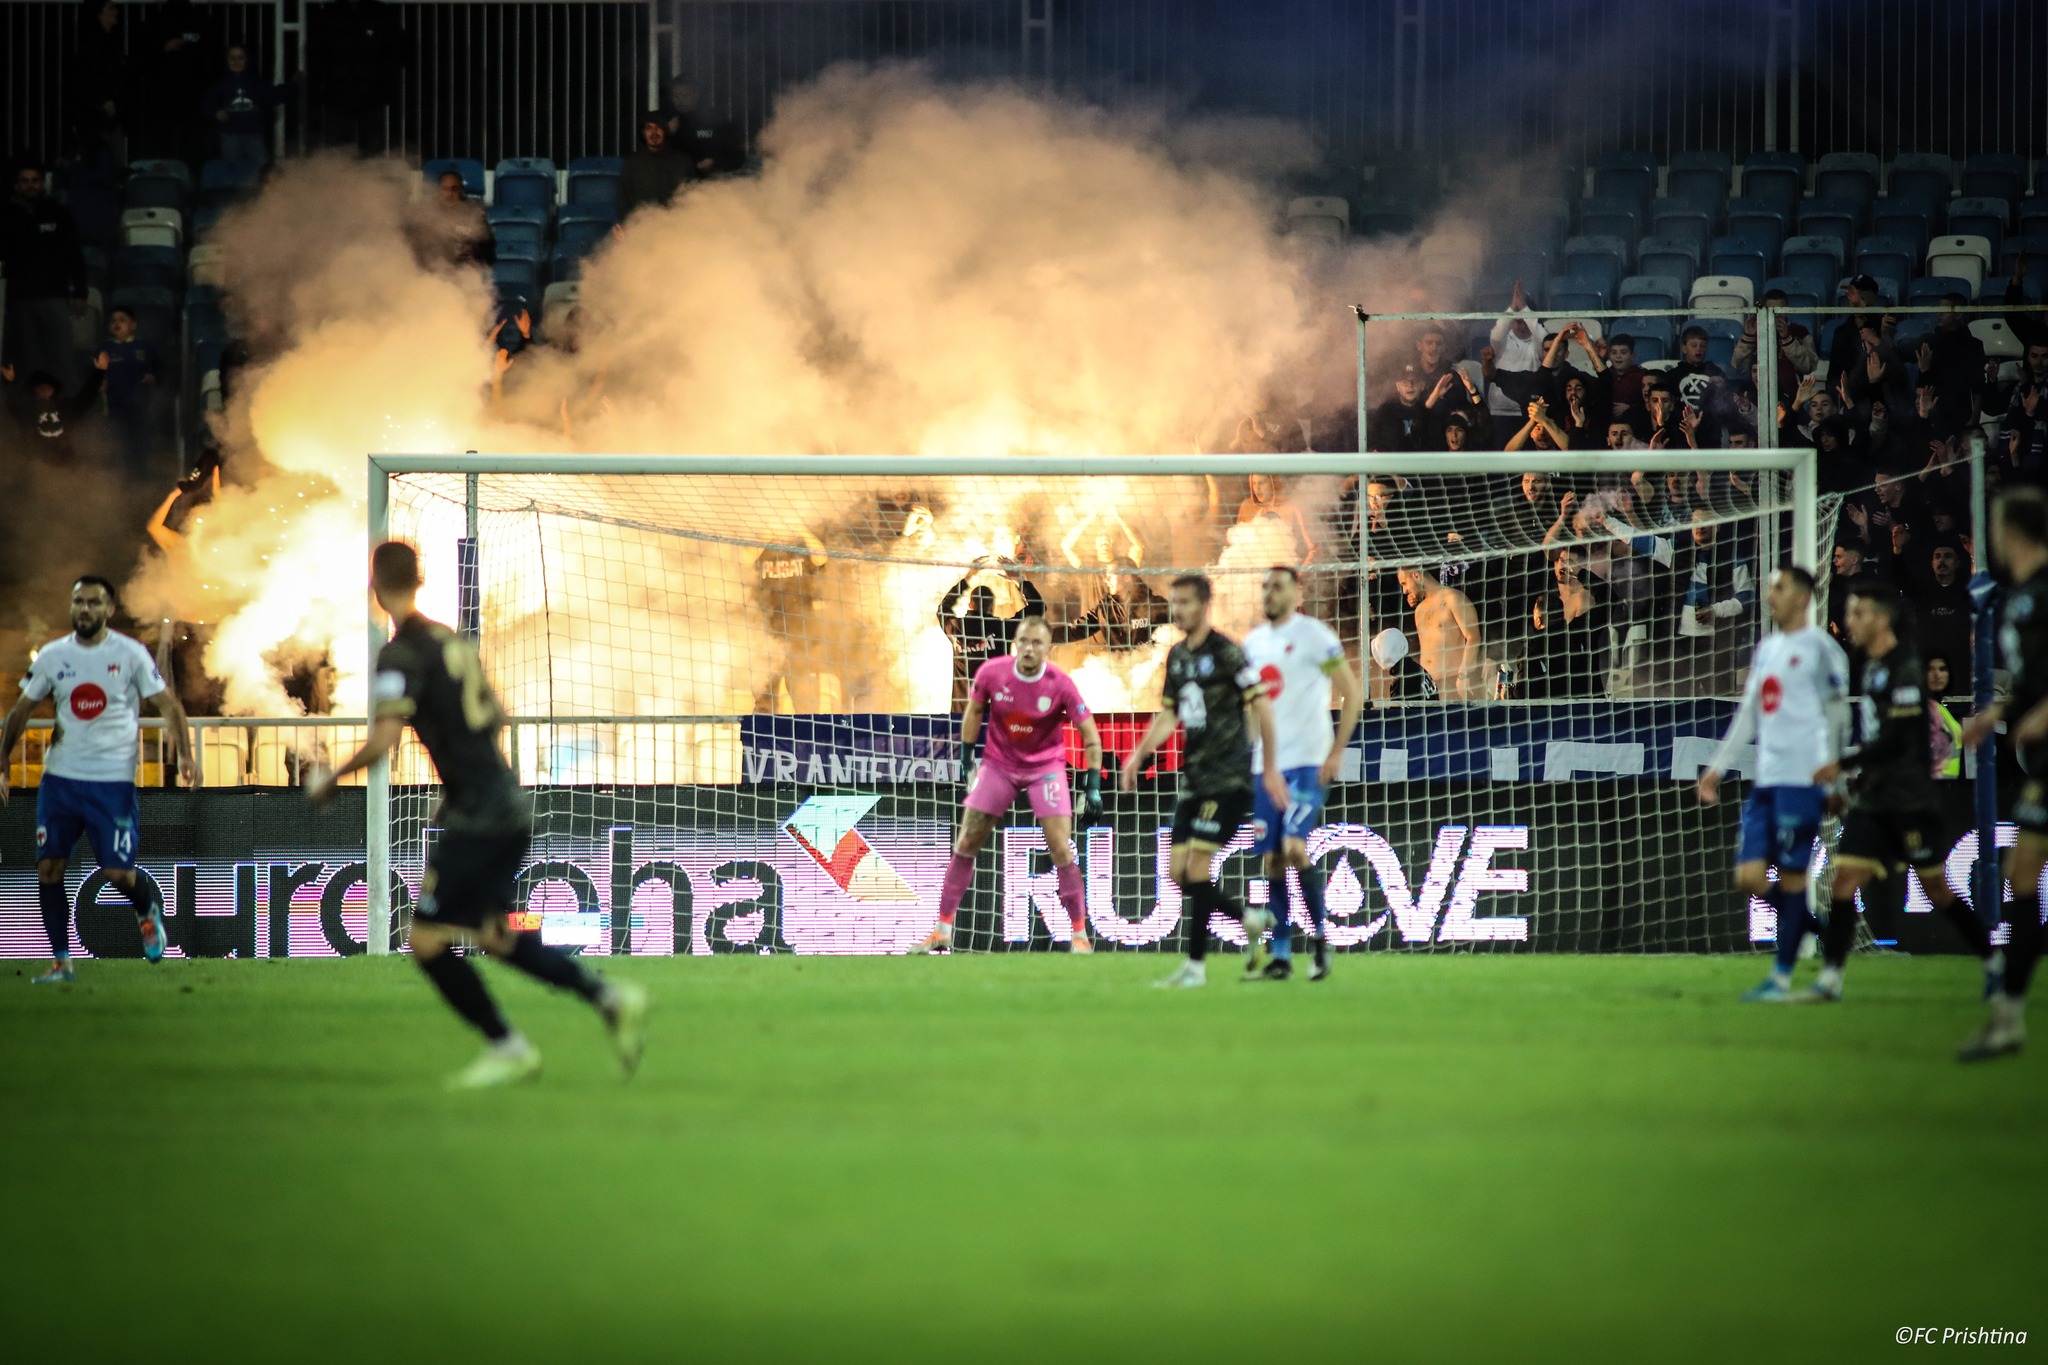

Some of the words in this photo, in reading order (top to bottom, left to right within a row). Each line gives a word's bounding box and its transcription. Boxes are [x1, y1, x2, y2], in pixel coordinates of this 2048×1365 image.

[1131, 618, 1149, 629] 1987
[1043, 782, 1061, 801] 12
[113, 829, 132, 854] 14
